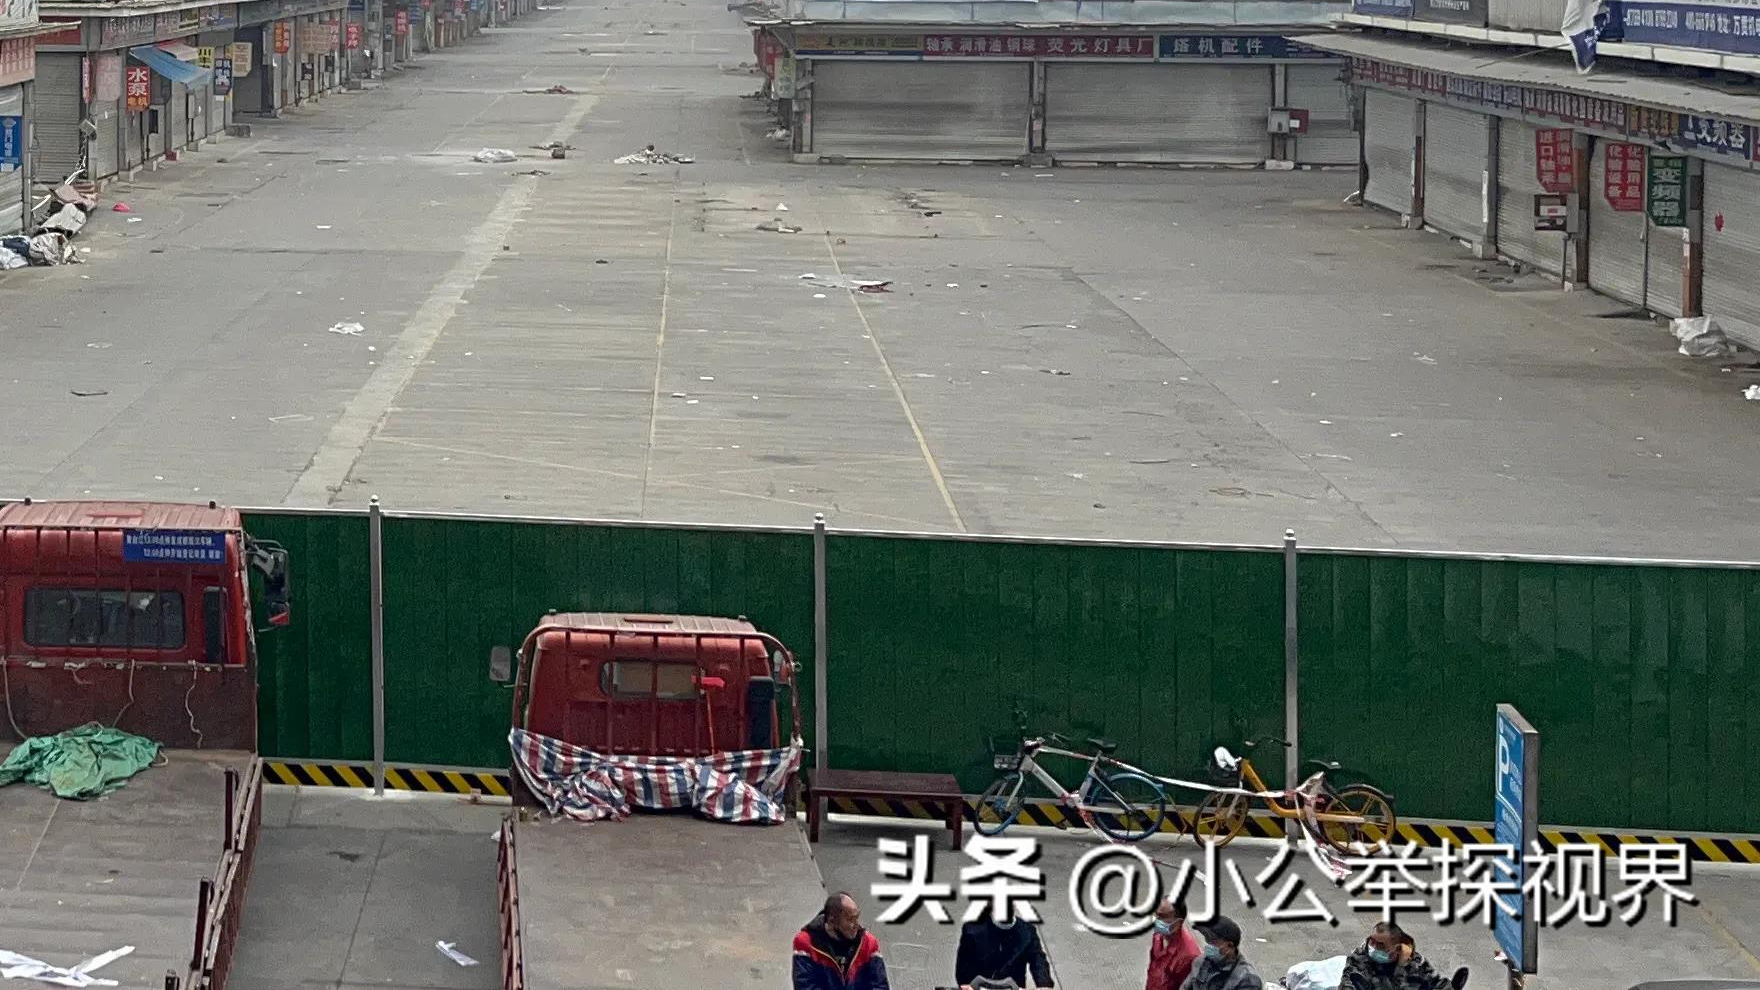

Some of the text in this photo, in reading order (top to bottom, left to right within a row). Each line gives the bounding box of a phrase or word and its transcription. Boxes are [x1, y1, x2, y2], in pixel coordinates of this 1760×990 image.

[1047, 37, 1154, 53] 荧光灯具厂
[1173, 38, 1264, 54] 塔机配件
[127, 68, 148, 97] 水泵
